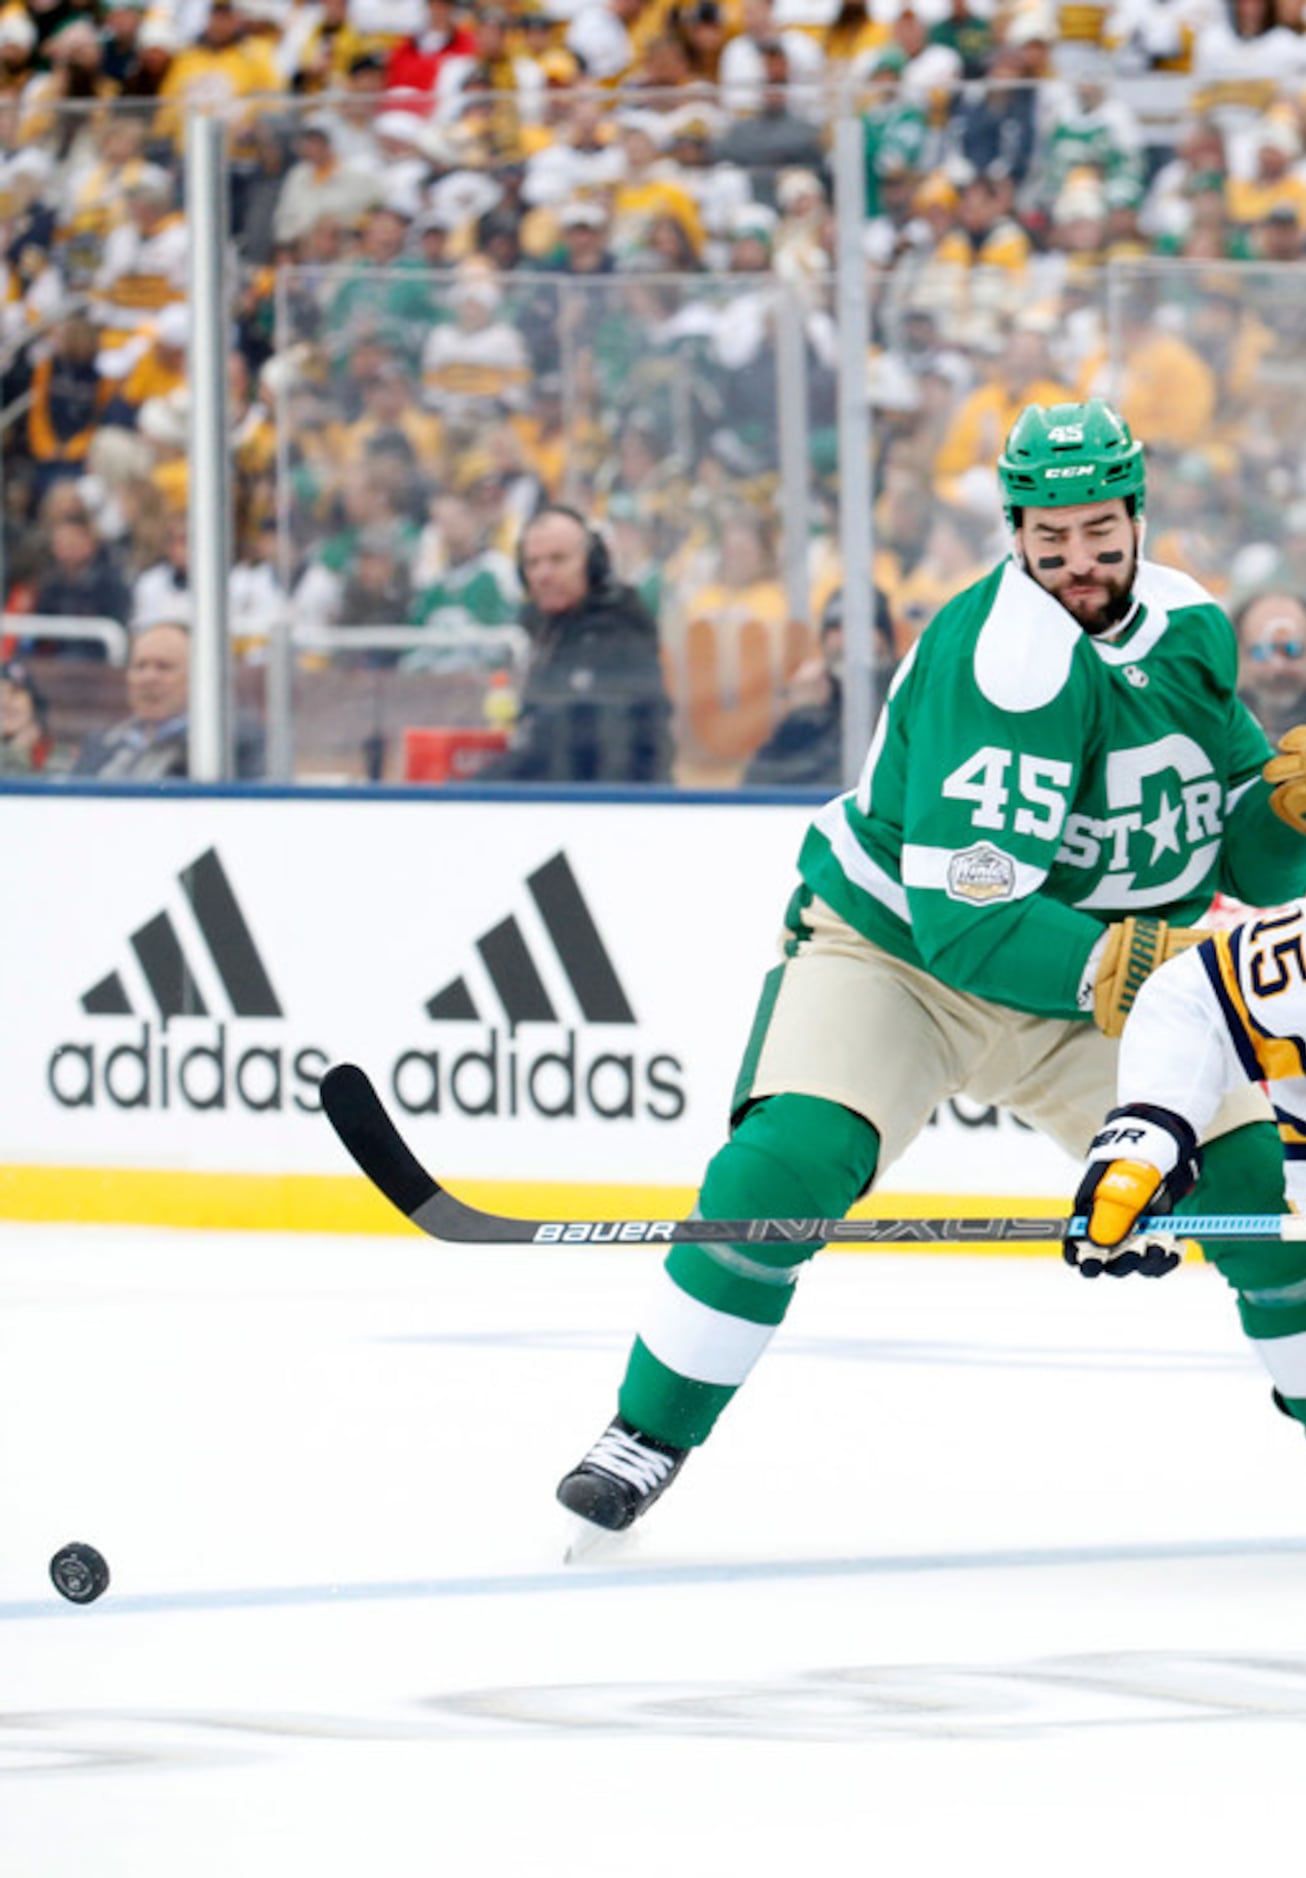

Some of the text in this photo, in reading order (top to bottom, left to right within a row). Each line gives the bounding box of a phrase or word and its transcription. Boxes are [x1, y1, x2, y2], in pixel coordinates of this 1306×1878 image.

[1048, 423, 1084, 442] 45
[1045, 464, 1096, 479] CCM
[941, 745, 1073, 842] 45
[48, 1022, 330, 1113] adidas
[392, 1027, 687, 1120] adidas
[532, 1221, 678, 1243] BAUER
[748, 1218, 1070, 1242] NEXUS
